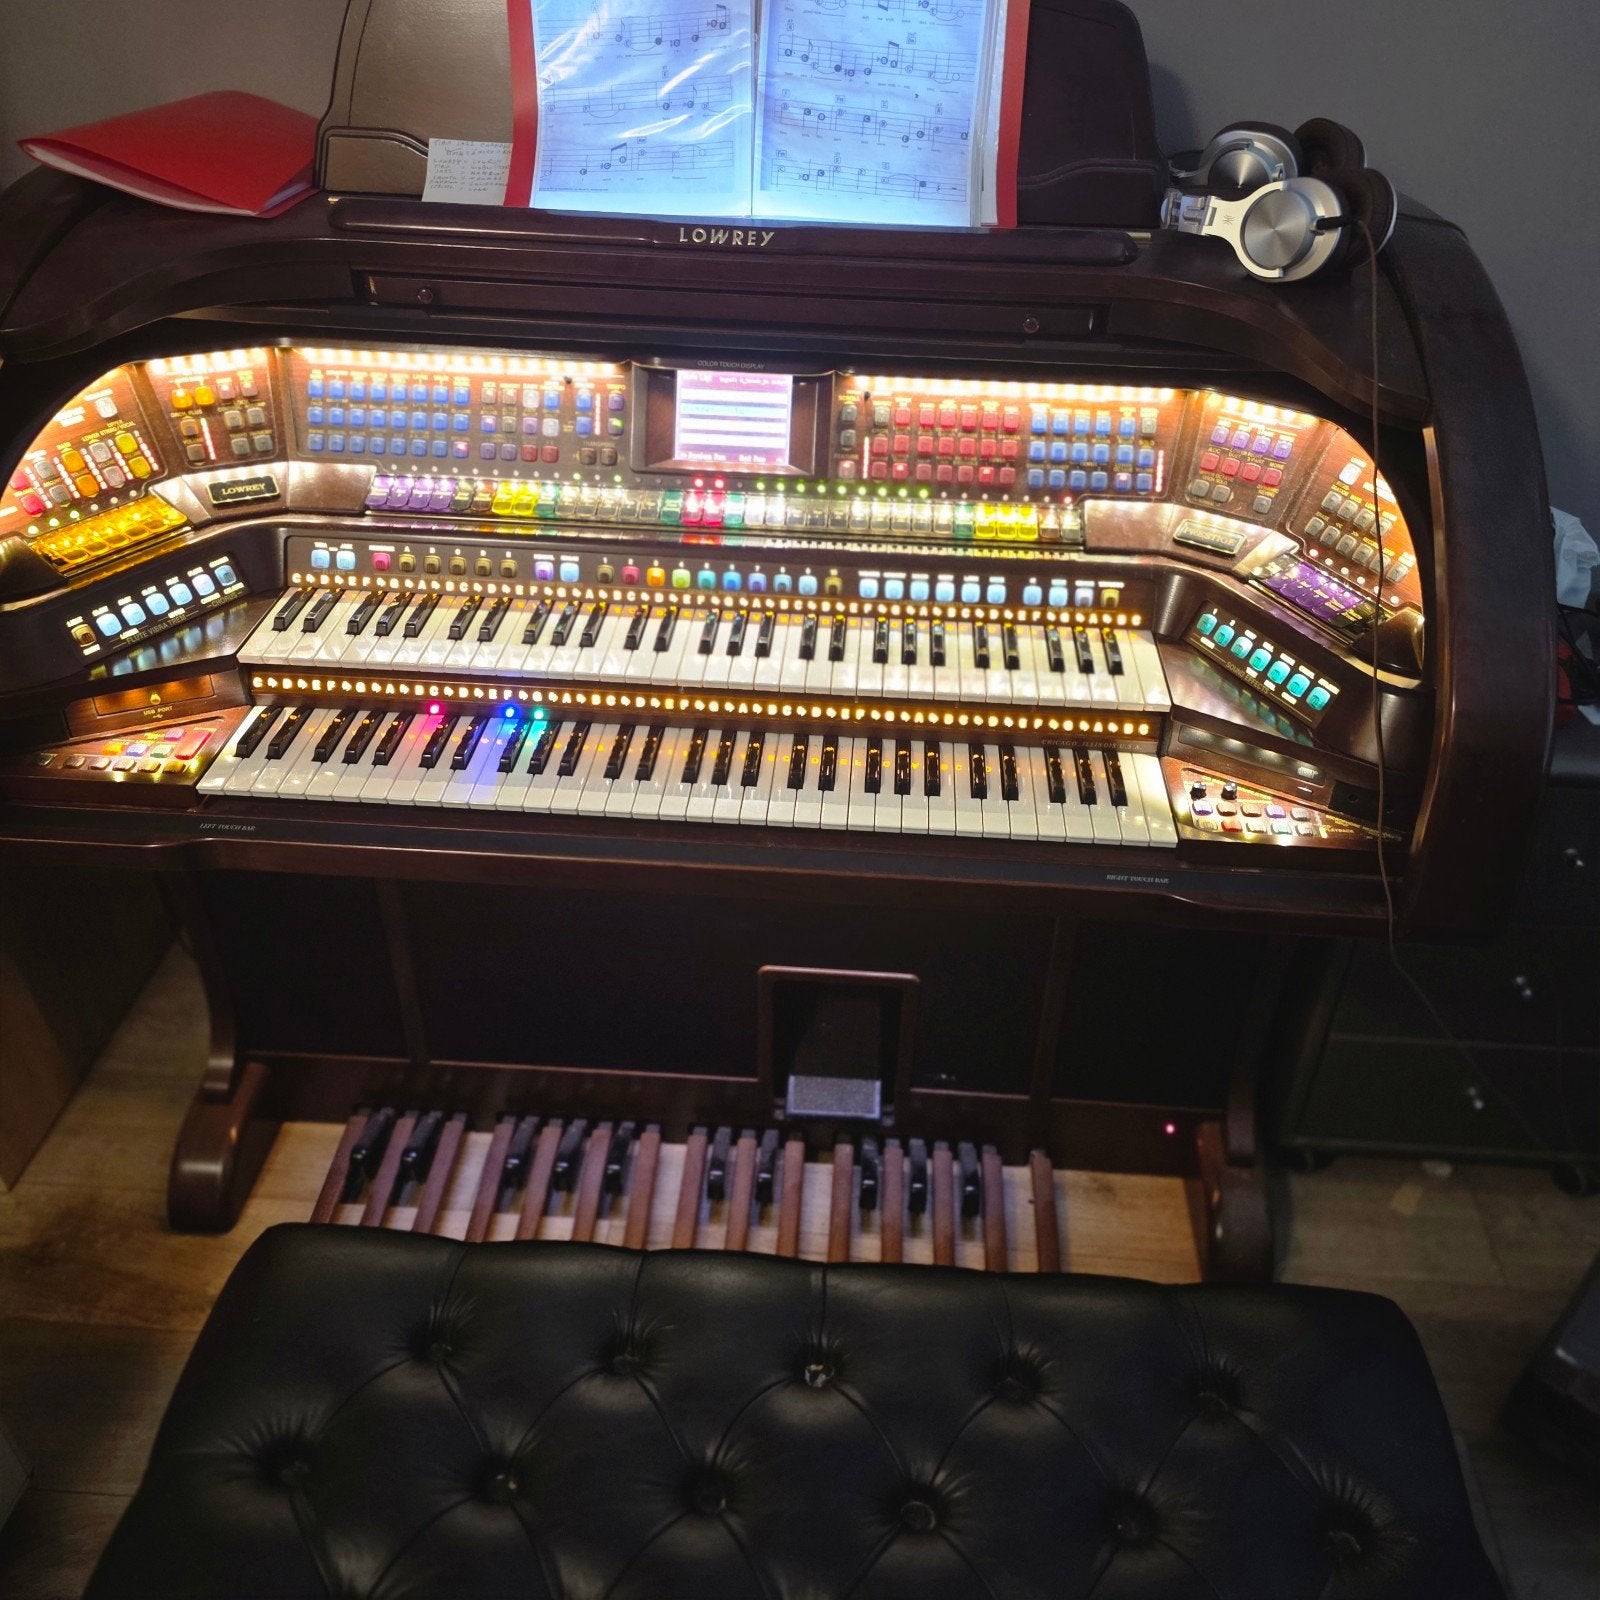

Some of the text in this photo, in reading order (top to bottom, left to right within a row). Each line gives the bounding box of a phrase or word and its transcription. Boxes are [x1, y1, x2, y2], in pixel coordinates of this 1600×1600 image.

[679, 227, 775, 247] LOWREY
[221, 483, 266, 495] LOWREY
[1183, 526, 1237, 546] PRESTIGE
[211, 594, 239, 607] CHORUS
[126, 614, 187, 645] FLUTE VIBRA TREM
[1244, 672, 1270, 694] EFFECTS
[157, 705, 173, 713] PORT
